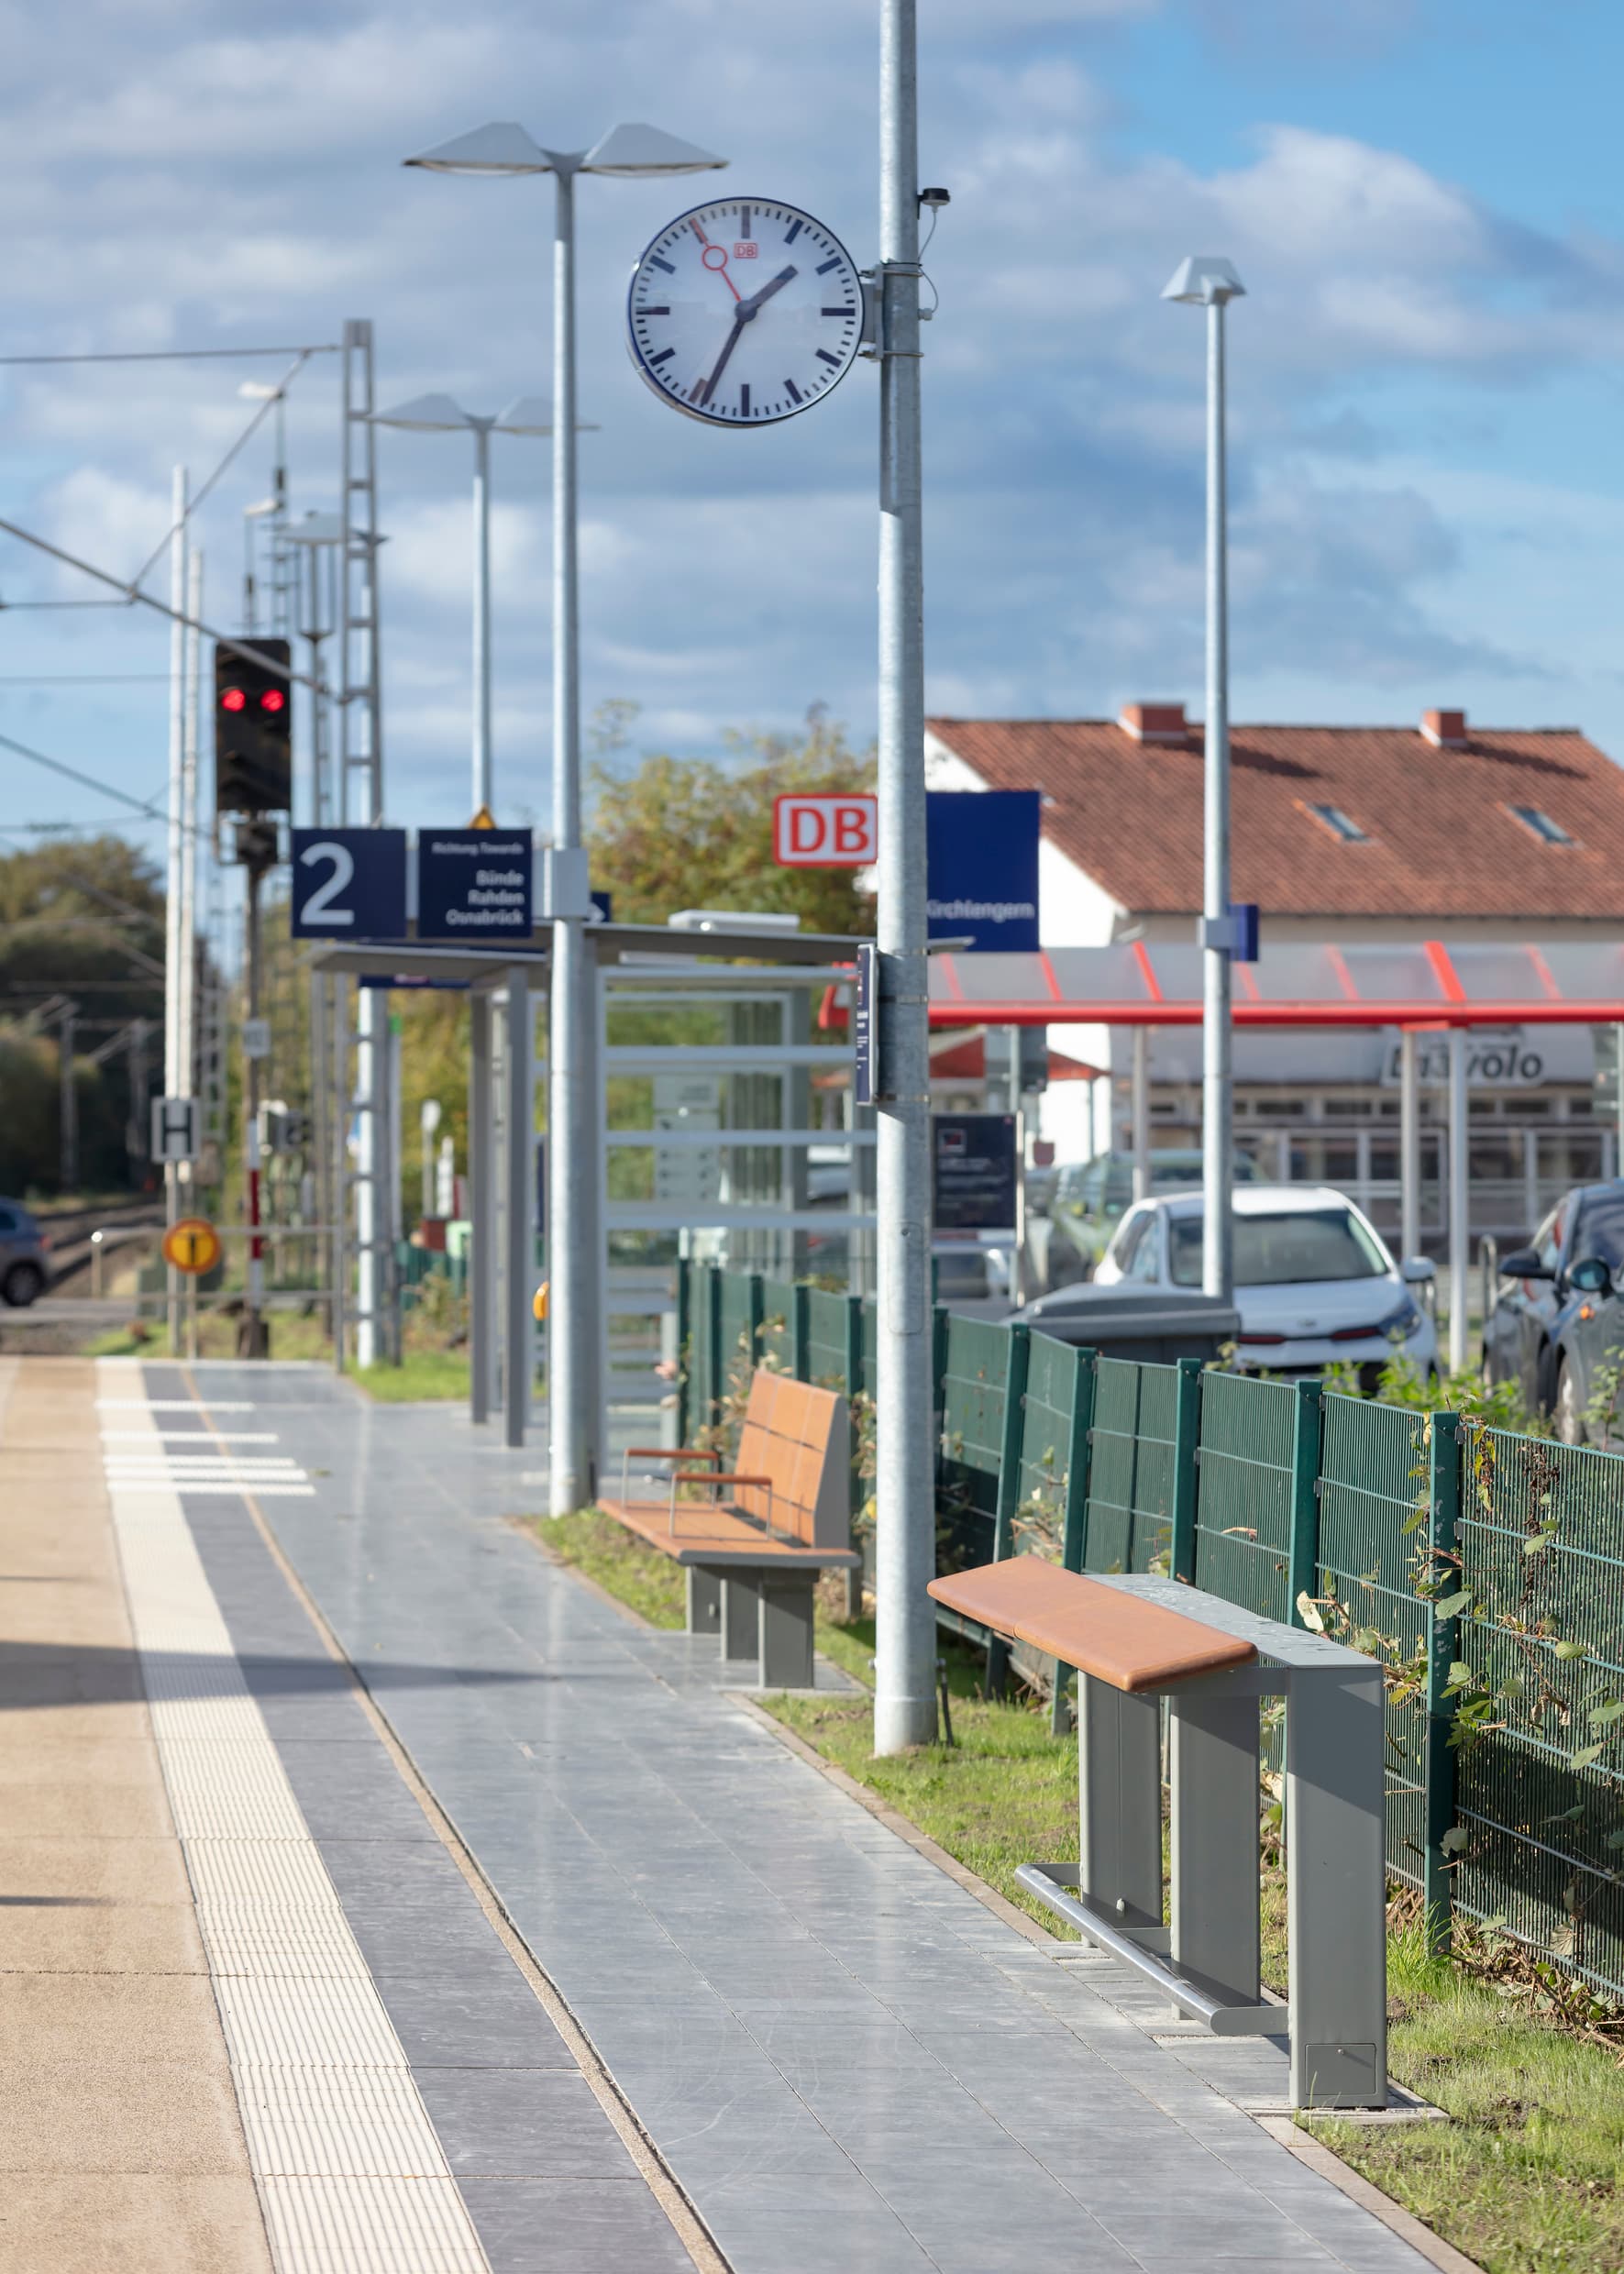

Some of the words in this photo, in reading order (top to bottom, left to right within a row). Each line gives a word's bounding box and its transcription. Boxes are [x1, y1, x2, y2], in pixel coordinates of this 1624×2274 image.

[736, 245, 755, 257] DB
[790, 807, 869, 854] DB
[300, 842, 355, 926] 2
[476, 869, 525, 887] Bünde
[468, 889, 525, 906] Rahden
[445, 909, 525, 926] Osnabrück
